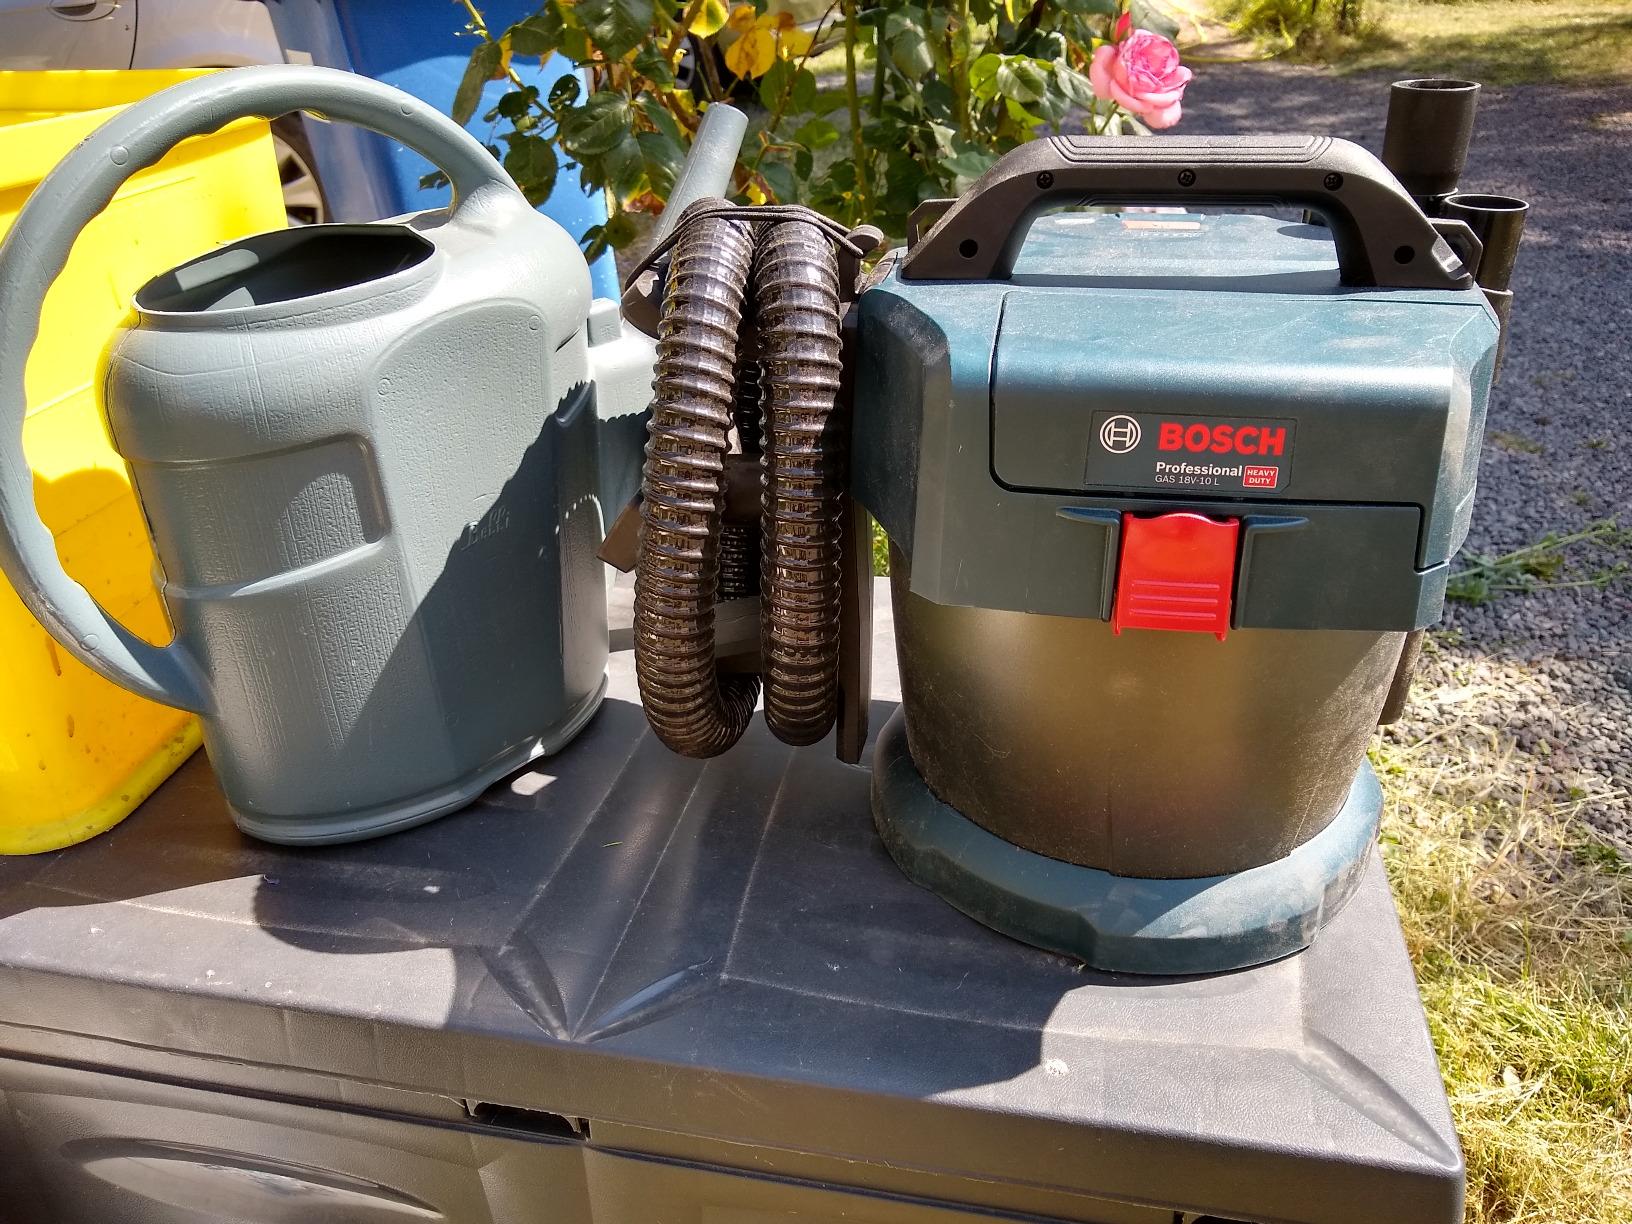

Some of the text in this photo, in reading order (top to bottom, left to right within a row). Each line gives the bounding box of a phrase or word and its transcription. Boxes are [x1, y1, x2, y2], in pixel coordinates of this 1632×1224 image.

[1159, 422, 1286, 456] BOSCH
[1156, 462, 1242, 477] Professional
[1247, 469, 1275, 477] HEAVY
[1155, 475, 1220, 486] GAS 18V-10 L
[1249, 477, 1271, 485] DUTY
